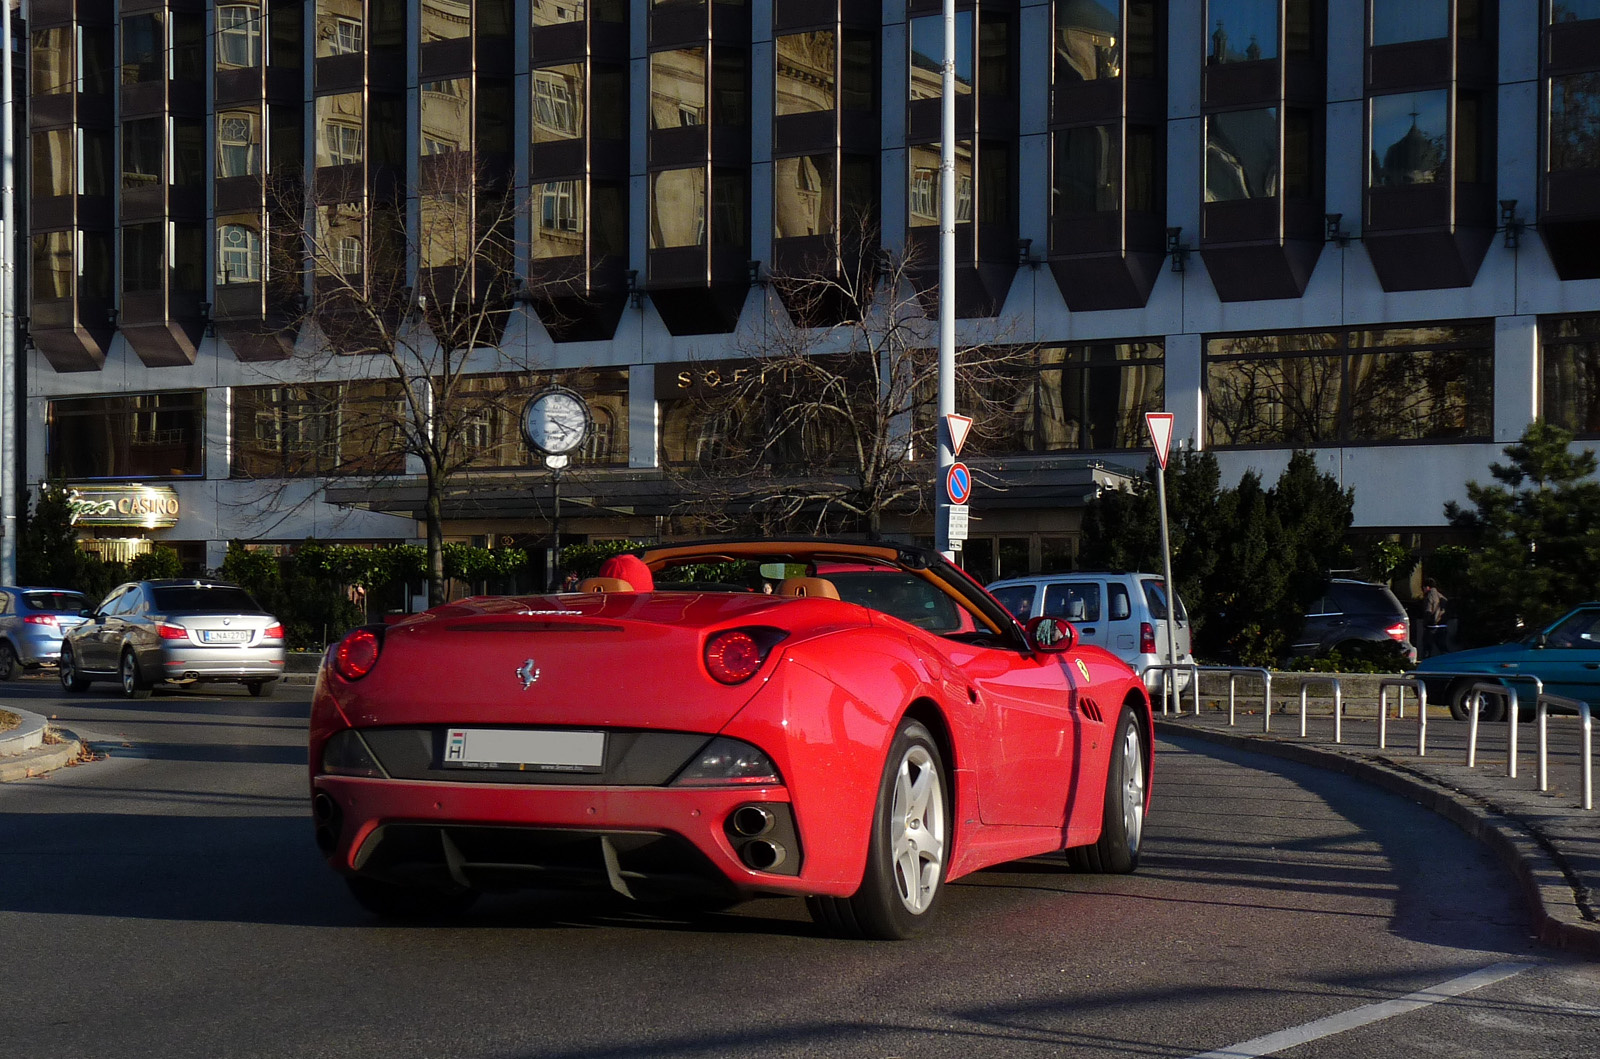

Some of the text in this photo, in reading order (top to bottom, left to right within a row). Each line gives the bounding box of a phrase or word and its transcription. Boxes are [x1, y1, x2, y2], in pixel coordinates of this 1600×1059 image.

[677, 366, 848, 389] SOFITE
[118, 497, 179, 514] CASINO
[449, 745, 461, 759] H
